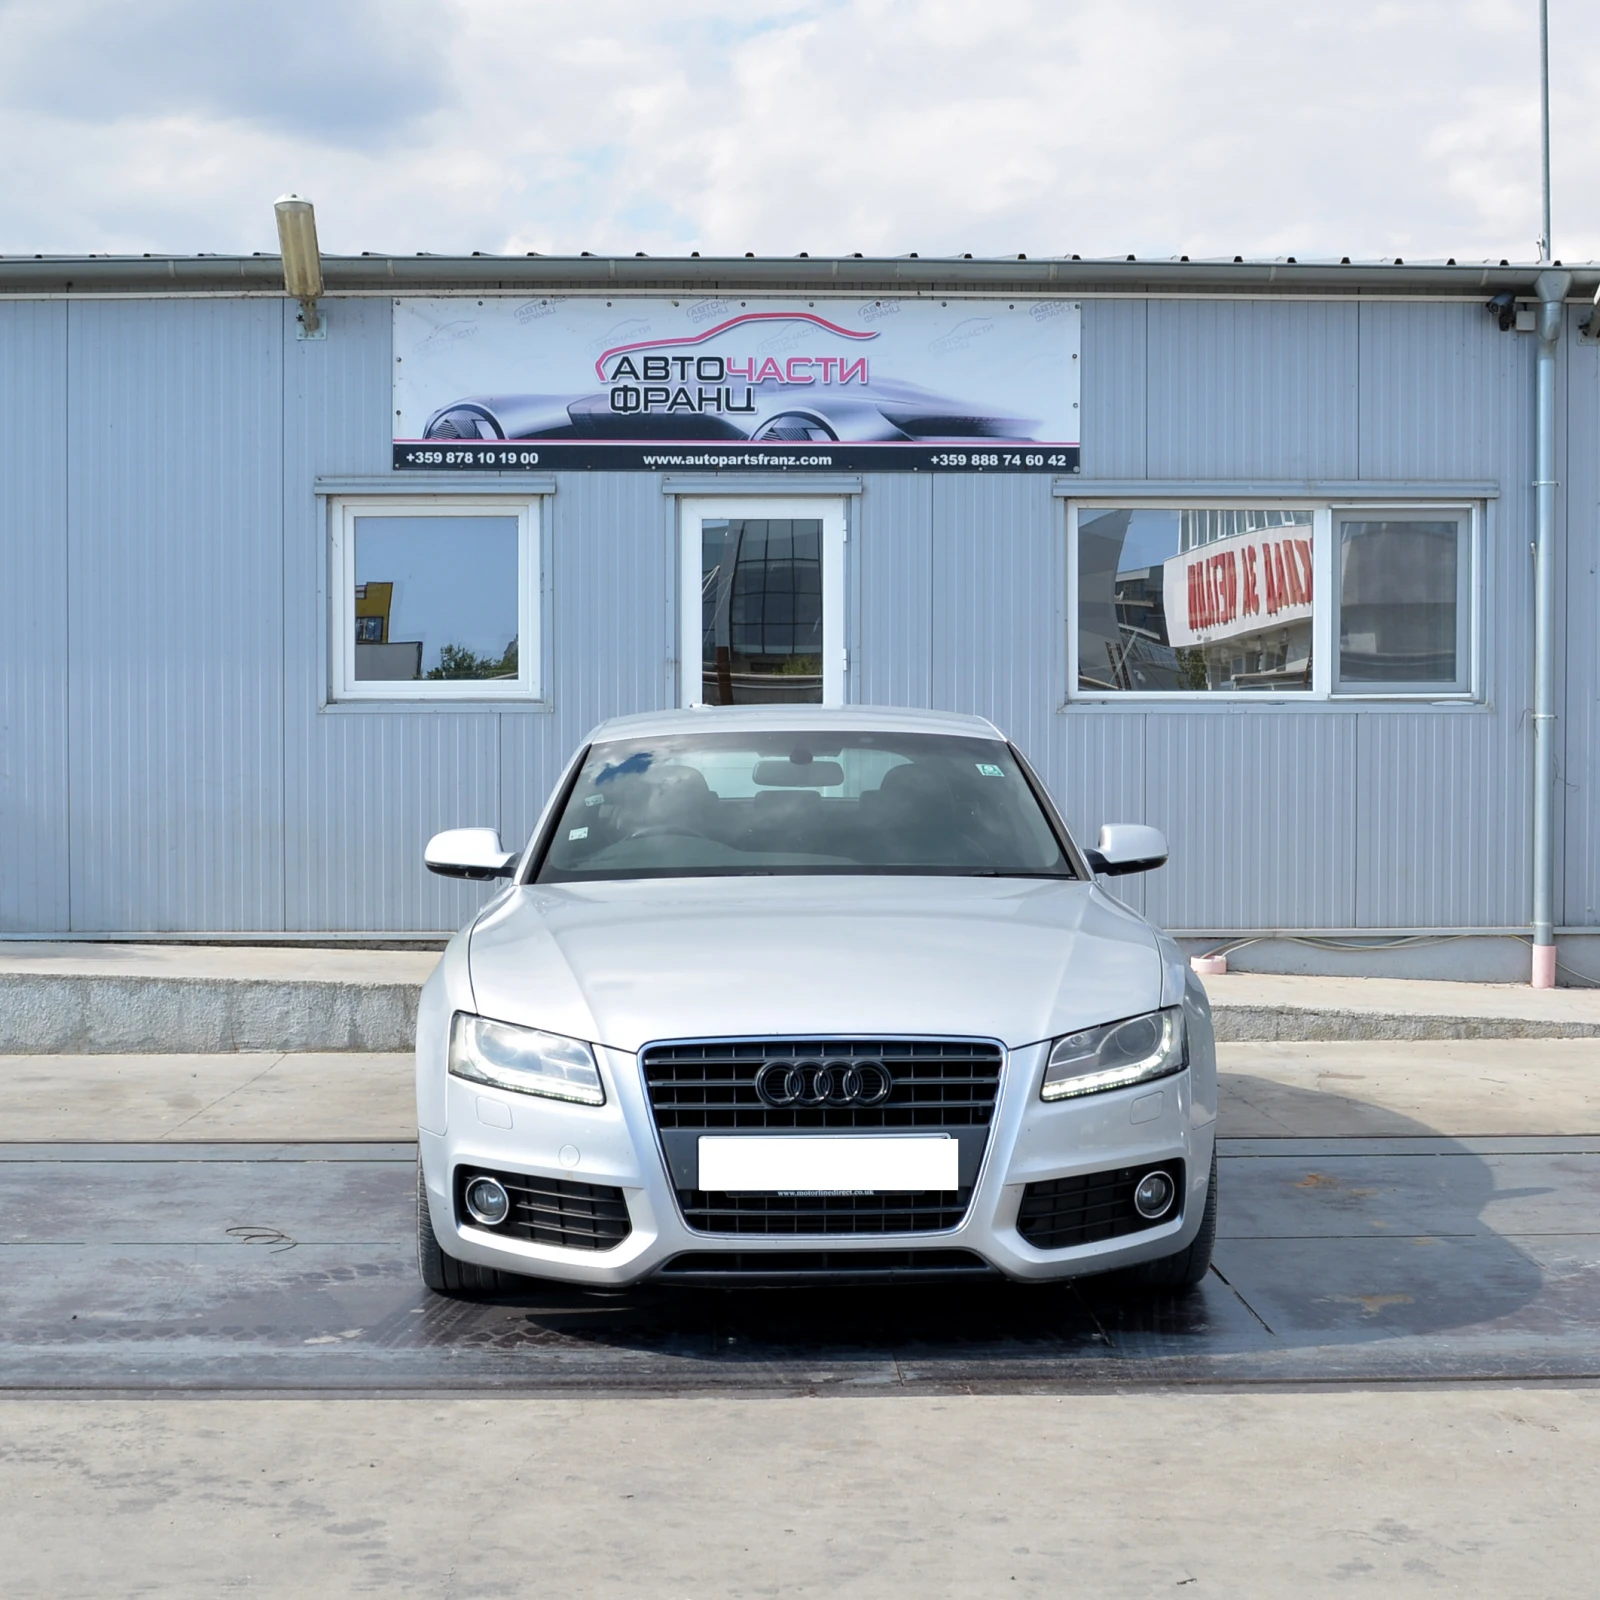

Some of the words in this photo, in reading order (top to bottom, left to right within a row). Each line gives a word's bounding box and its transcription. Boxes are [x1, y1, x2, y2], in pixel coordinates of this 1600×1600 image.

[610, 356, 867, 383] АВТОЧАСТИ
[610, 385, 755, 413] ФРАНЦ
[406, 452, 443, 464] +359
[446, 452, 474, 464] 878
[477, 452, 496, 464] 10
[499, 452, 517, 464] 19
[520, 452, 539, 464] 00
[643, 453, 832, 467] www.autopartsfranz.com
[931, 454, 967, 466] +359
[971, 454, 999, 466] 888
[1003, 454, 1021, 466] 74
[1025, 454, 1044, 466] 60
[1047, 454, 1067, 466] 42
